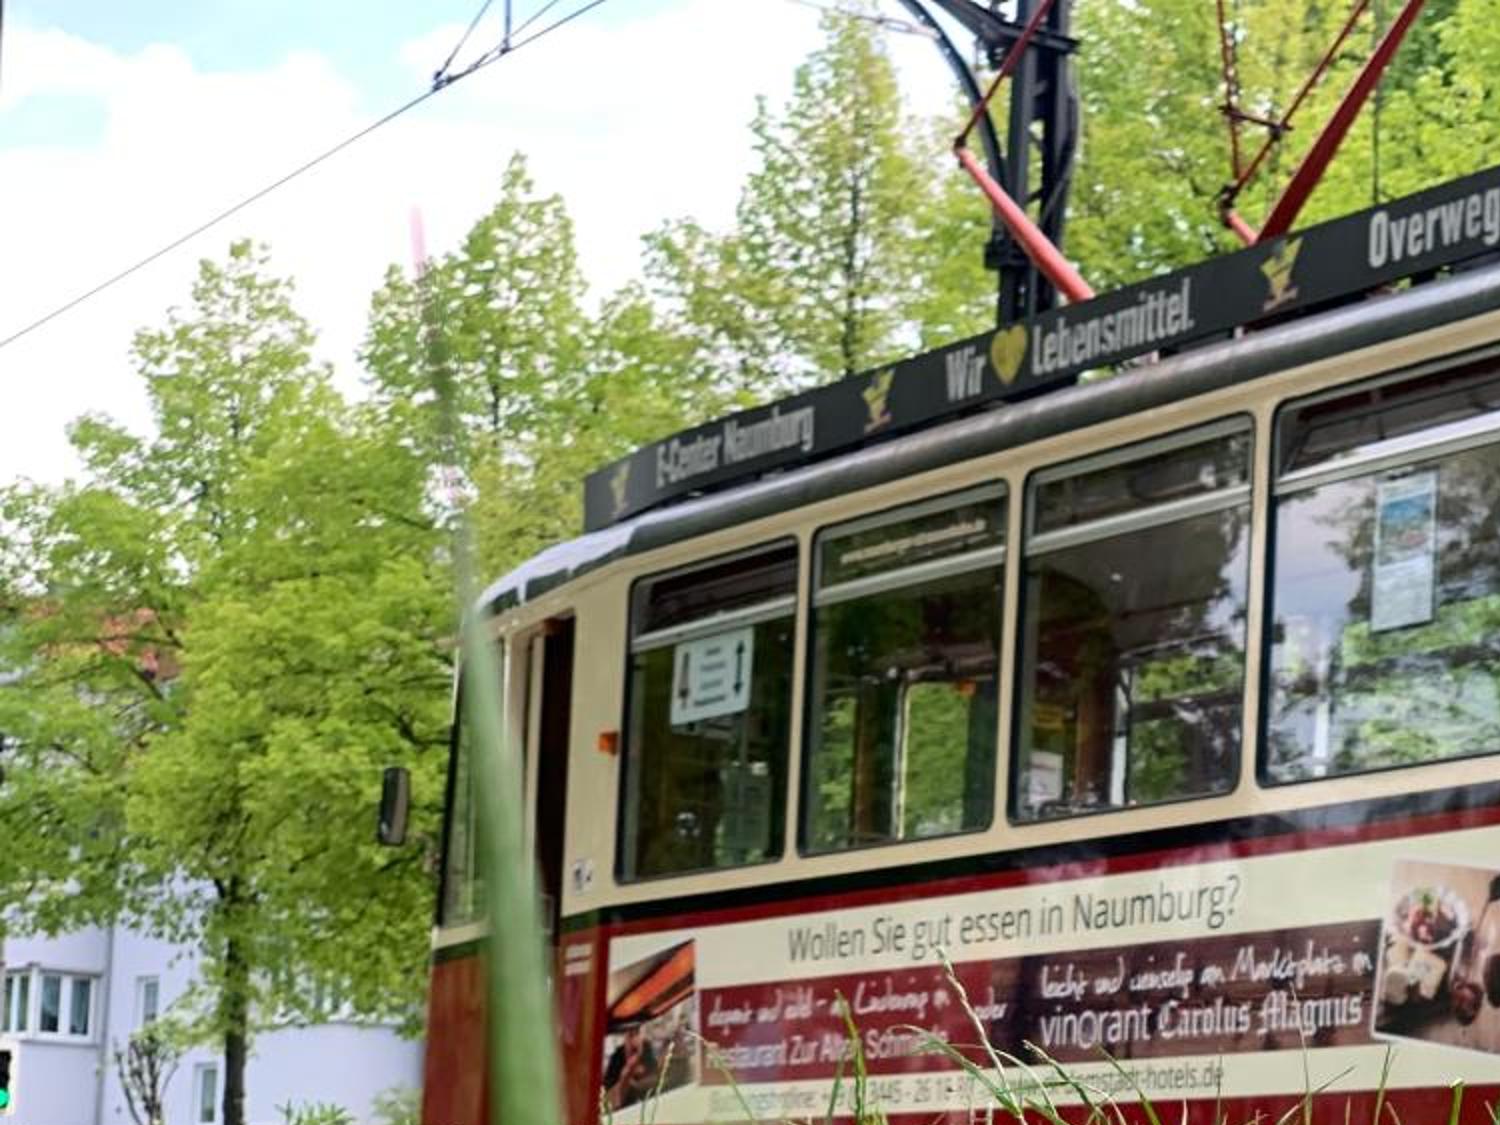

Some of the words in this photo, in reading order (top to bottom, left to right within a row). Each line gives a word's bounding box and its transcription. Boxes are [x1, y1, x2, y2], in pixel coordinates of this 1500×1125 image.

[945, 346, 987, 400] Wir
[723, 405, 816, 466] Naumburg
[788, 922, 865, 961] Wollen
[872, 916, 906, 954] Sie
[911, 914, 953, 961] gut
[959, 907, 1031, 945] essen
[1039, 897, 1064, 935] in
[1073, 874, 1242, 932] Naumburg?
[1094, 955, 1126, 995] und
[1229, 939, 1347, 990] Marktplatz
[1158, 995, 1251, 1039] Carolus
[1257, 988, 1364, 1037] Magnus
[790, 1035, 819, 1066] Zur
[819, 1030, 865, 1063] Alte
